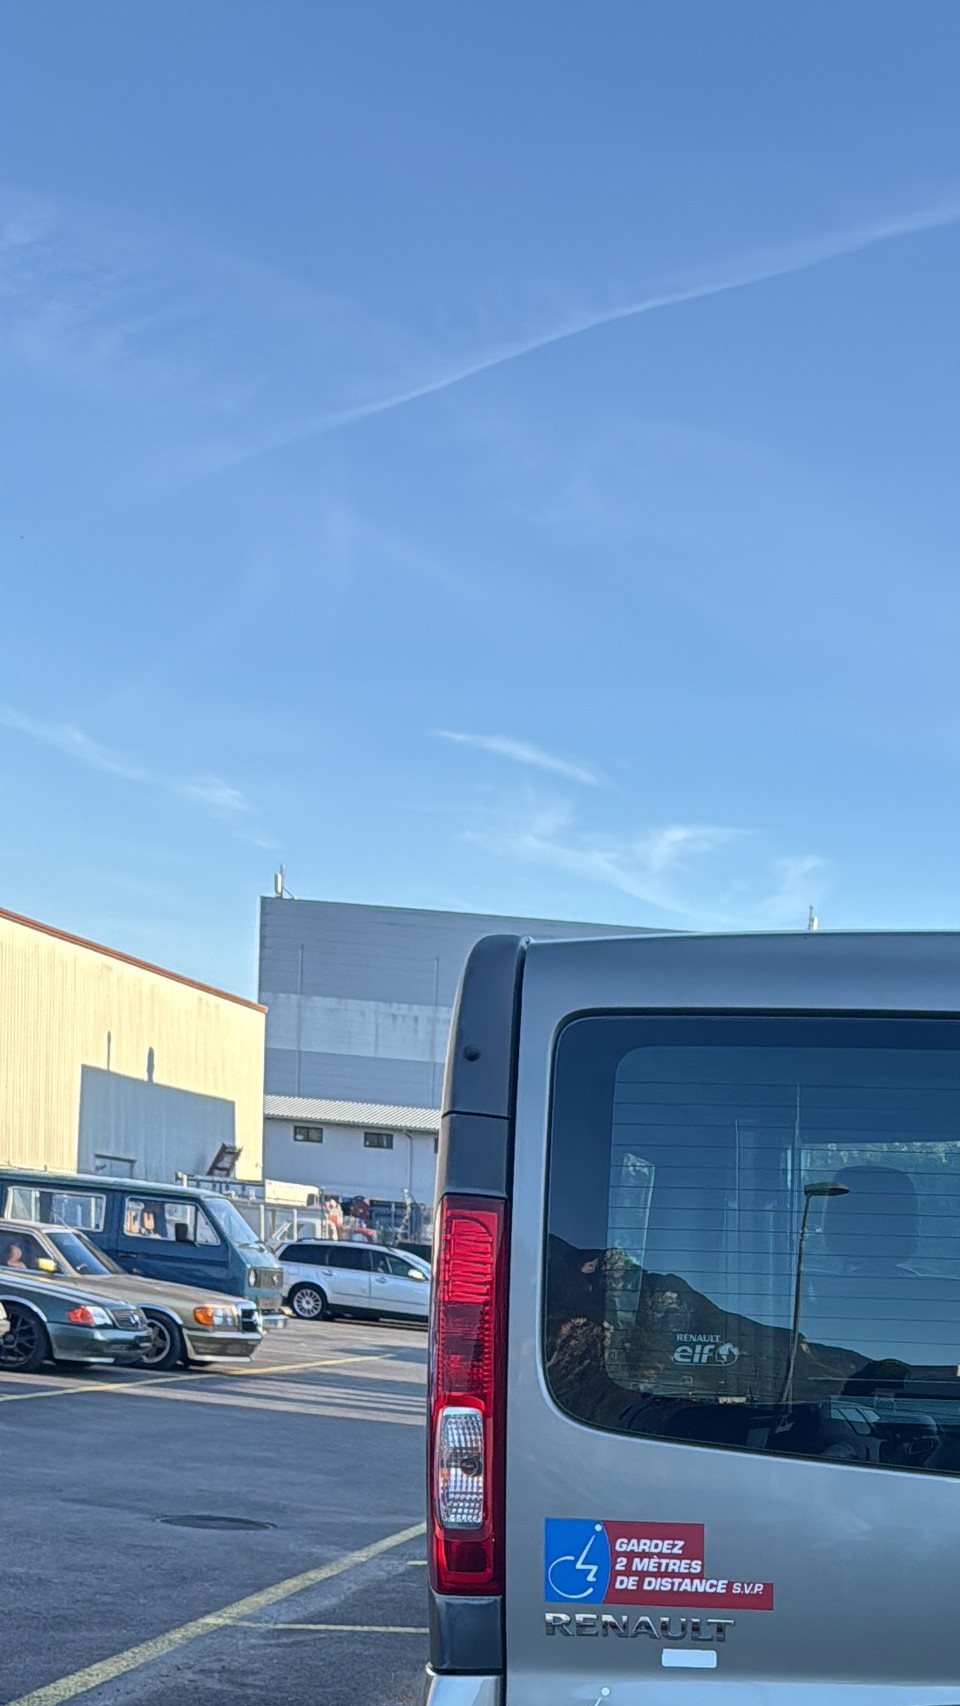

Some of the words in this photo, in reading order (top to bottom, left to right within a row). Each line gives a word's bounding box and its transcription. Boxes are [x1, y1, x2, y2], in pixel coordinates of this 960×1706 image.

[676, 1333, 721, 1342] RENAULT
[674, 1344, 715, 1363] elf
[614, 1537, 685, 1554] GARDEZ
[614, 1556, 628, 1571] 2
[631, 1554, 702, 1574] MÈTRES
[614, 1575, 639, 1590] DE
[642, 1576, 728, 1593] DISTANCE
[545, 1612, 736, 1642] RENAULT
